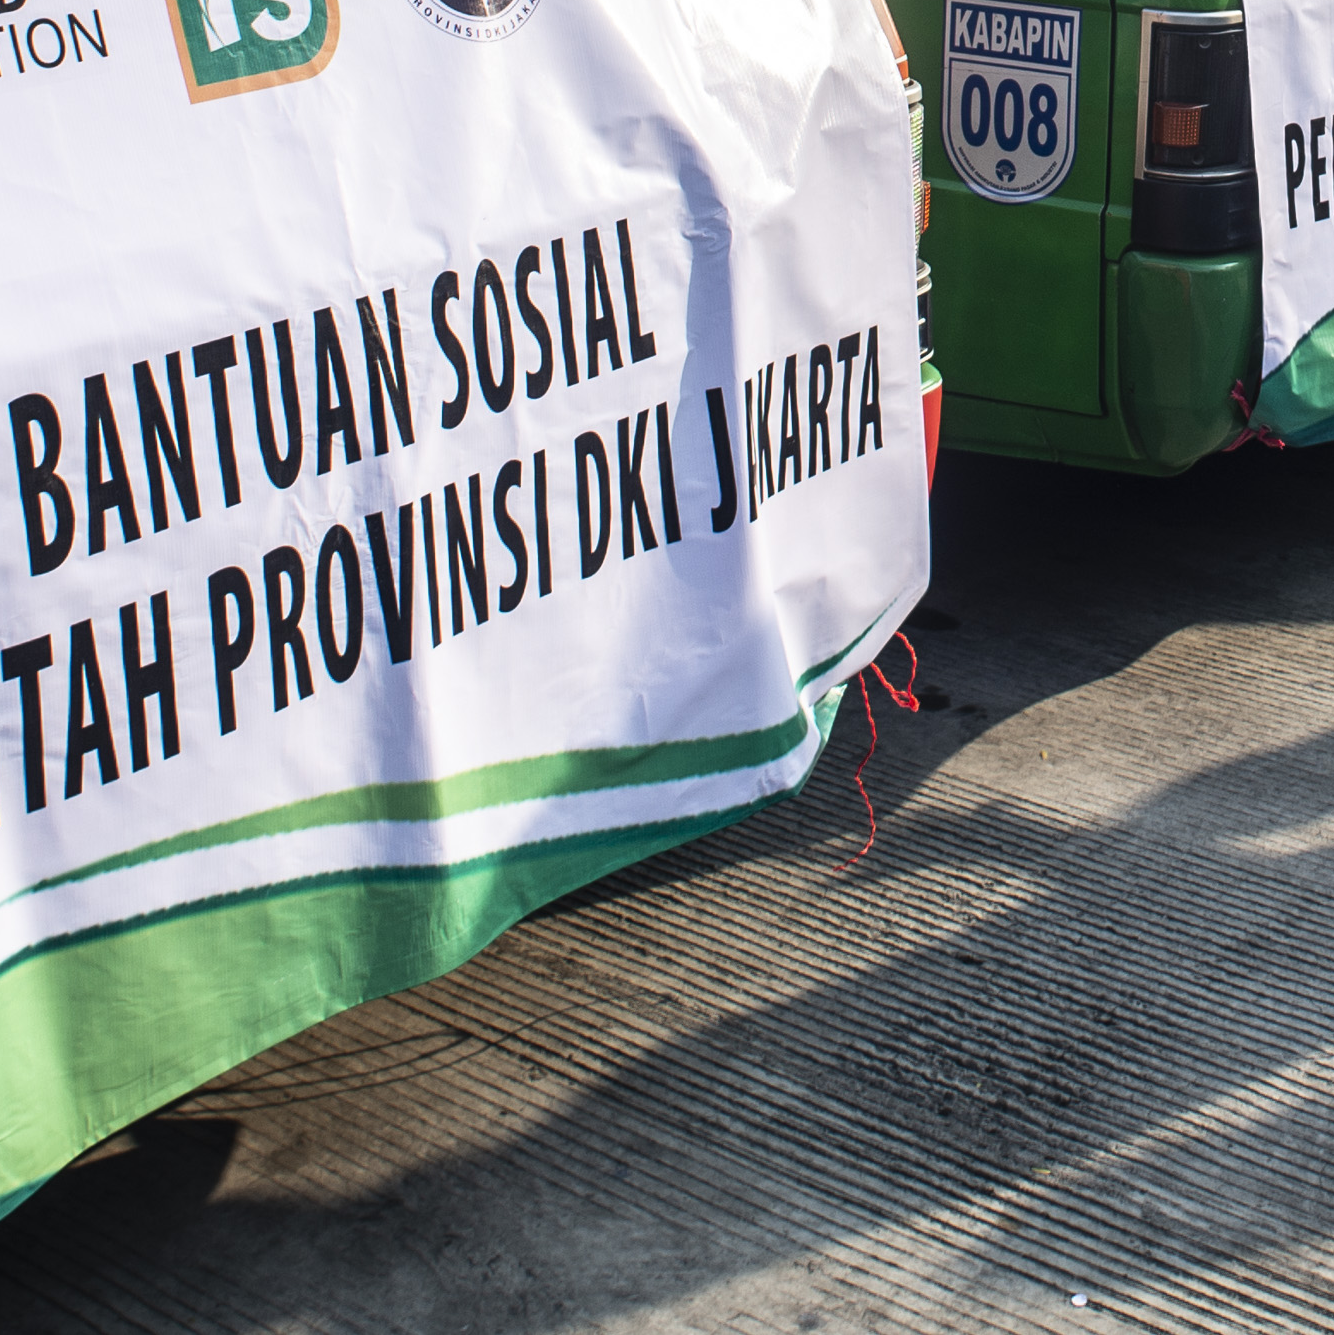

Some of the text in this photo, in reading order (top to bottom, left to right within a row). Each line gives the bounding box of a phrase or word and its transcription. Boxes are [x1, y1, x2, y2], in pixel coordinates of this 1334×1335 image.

[485, 23, 508, 39] DKI
[954, 8, 1071, 62] KABAPIN
[960, 73, 1059, 158] 008
[7, 218, 657, 578] BANTUAN SOSIAL
[207, 449, 552, 736] PROVINSI
[574, 402, 682, 581] DKI
